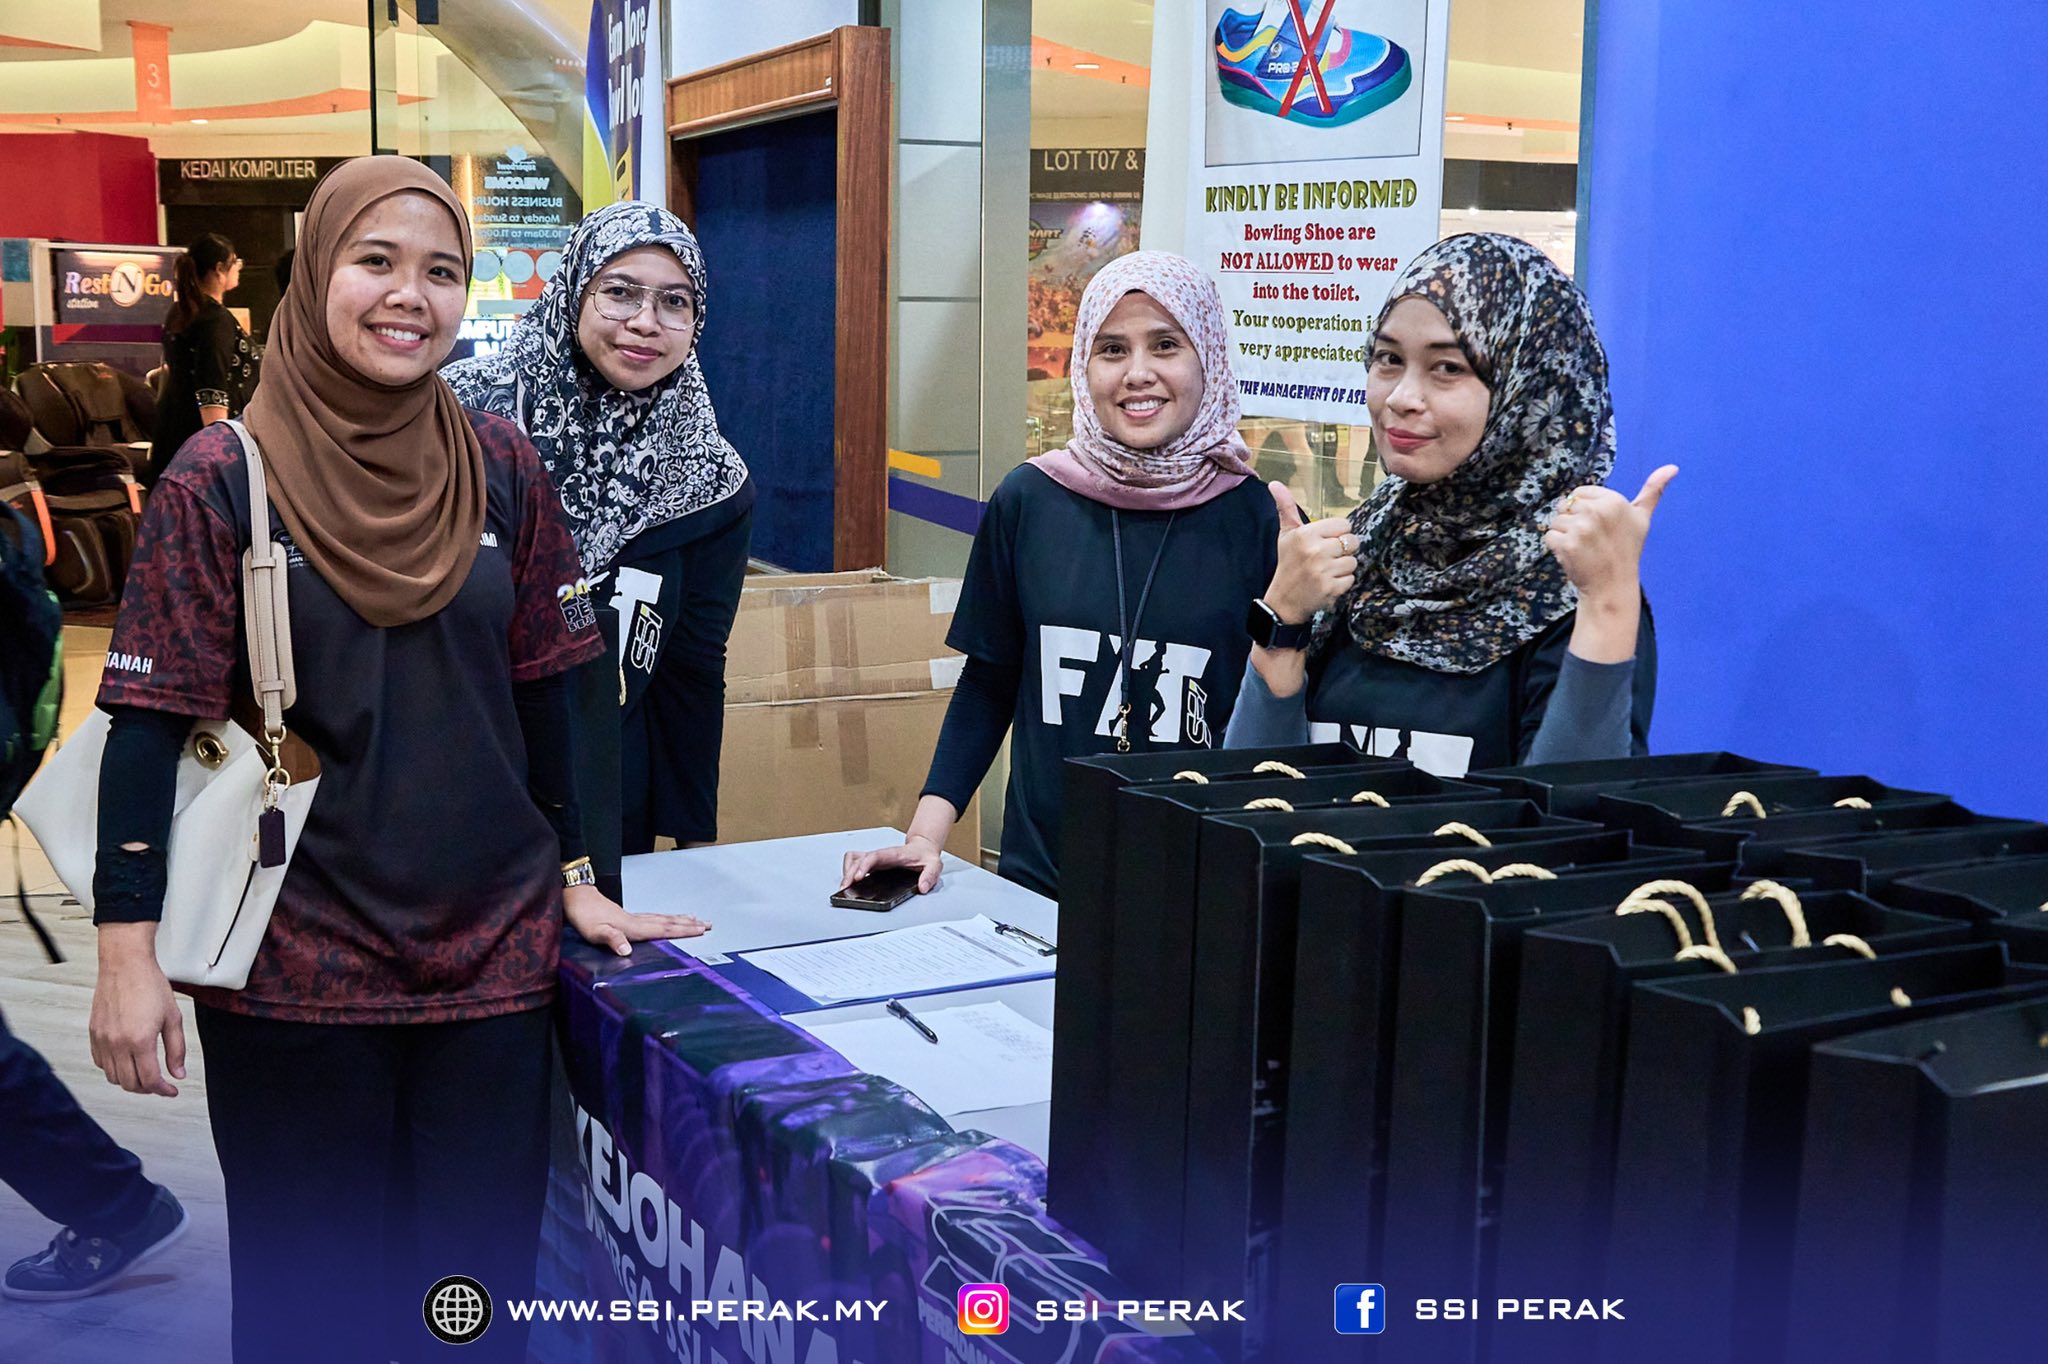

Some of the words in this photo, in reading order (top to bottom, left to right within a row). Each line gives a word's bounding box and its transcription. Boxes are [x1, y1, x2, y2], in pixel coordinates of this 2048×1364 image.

[147, 63, 160, 88] 3
[180, 161, 226, 179] KEDAI
[229, 160, 316, 179] KOMPUTER
[1044, 150, 1082, 171] LOT
[1086, 150, 1120, 171] T07
[1125, 149, 1139, 170] &
[1205, 185, 1270, 212] KINDLY
[1275, 183, 1299, 211] BE
[1303, 178, 1418, 210] INFORMED
[1244, 224, 1302, 244] Bowling
[1304, 223, 1345, 241] Shoe
[1348, 224, 1376, 240] are
[1220, 252, 1254, 271] NOT
[1256, 252, 1334, 271] ALLOWED
[1337, 253, 1352, 270] to
[1356, 257, 1398, 271] wear
[64, 271, 111, 295] Rest
[112, 270, 142, 294] N
[144, 273, 173, 297] Go
[1253, 282, 1279, 299] into
[1282, 283, 1309, 300] the
[1312, 284, 1360, 302] toilet.
[1233, 310, 1270, 328] Your
[1272, 314, 1362, 332] cooperation
[1239, 342, 1273, 360] very
[1239, 379, 1260, 396] THE
[1260, 381, 1330, 402] MANAGEMENT
[1331, 387, 1346, 403] OF
